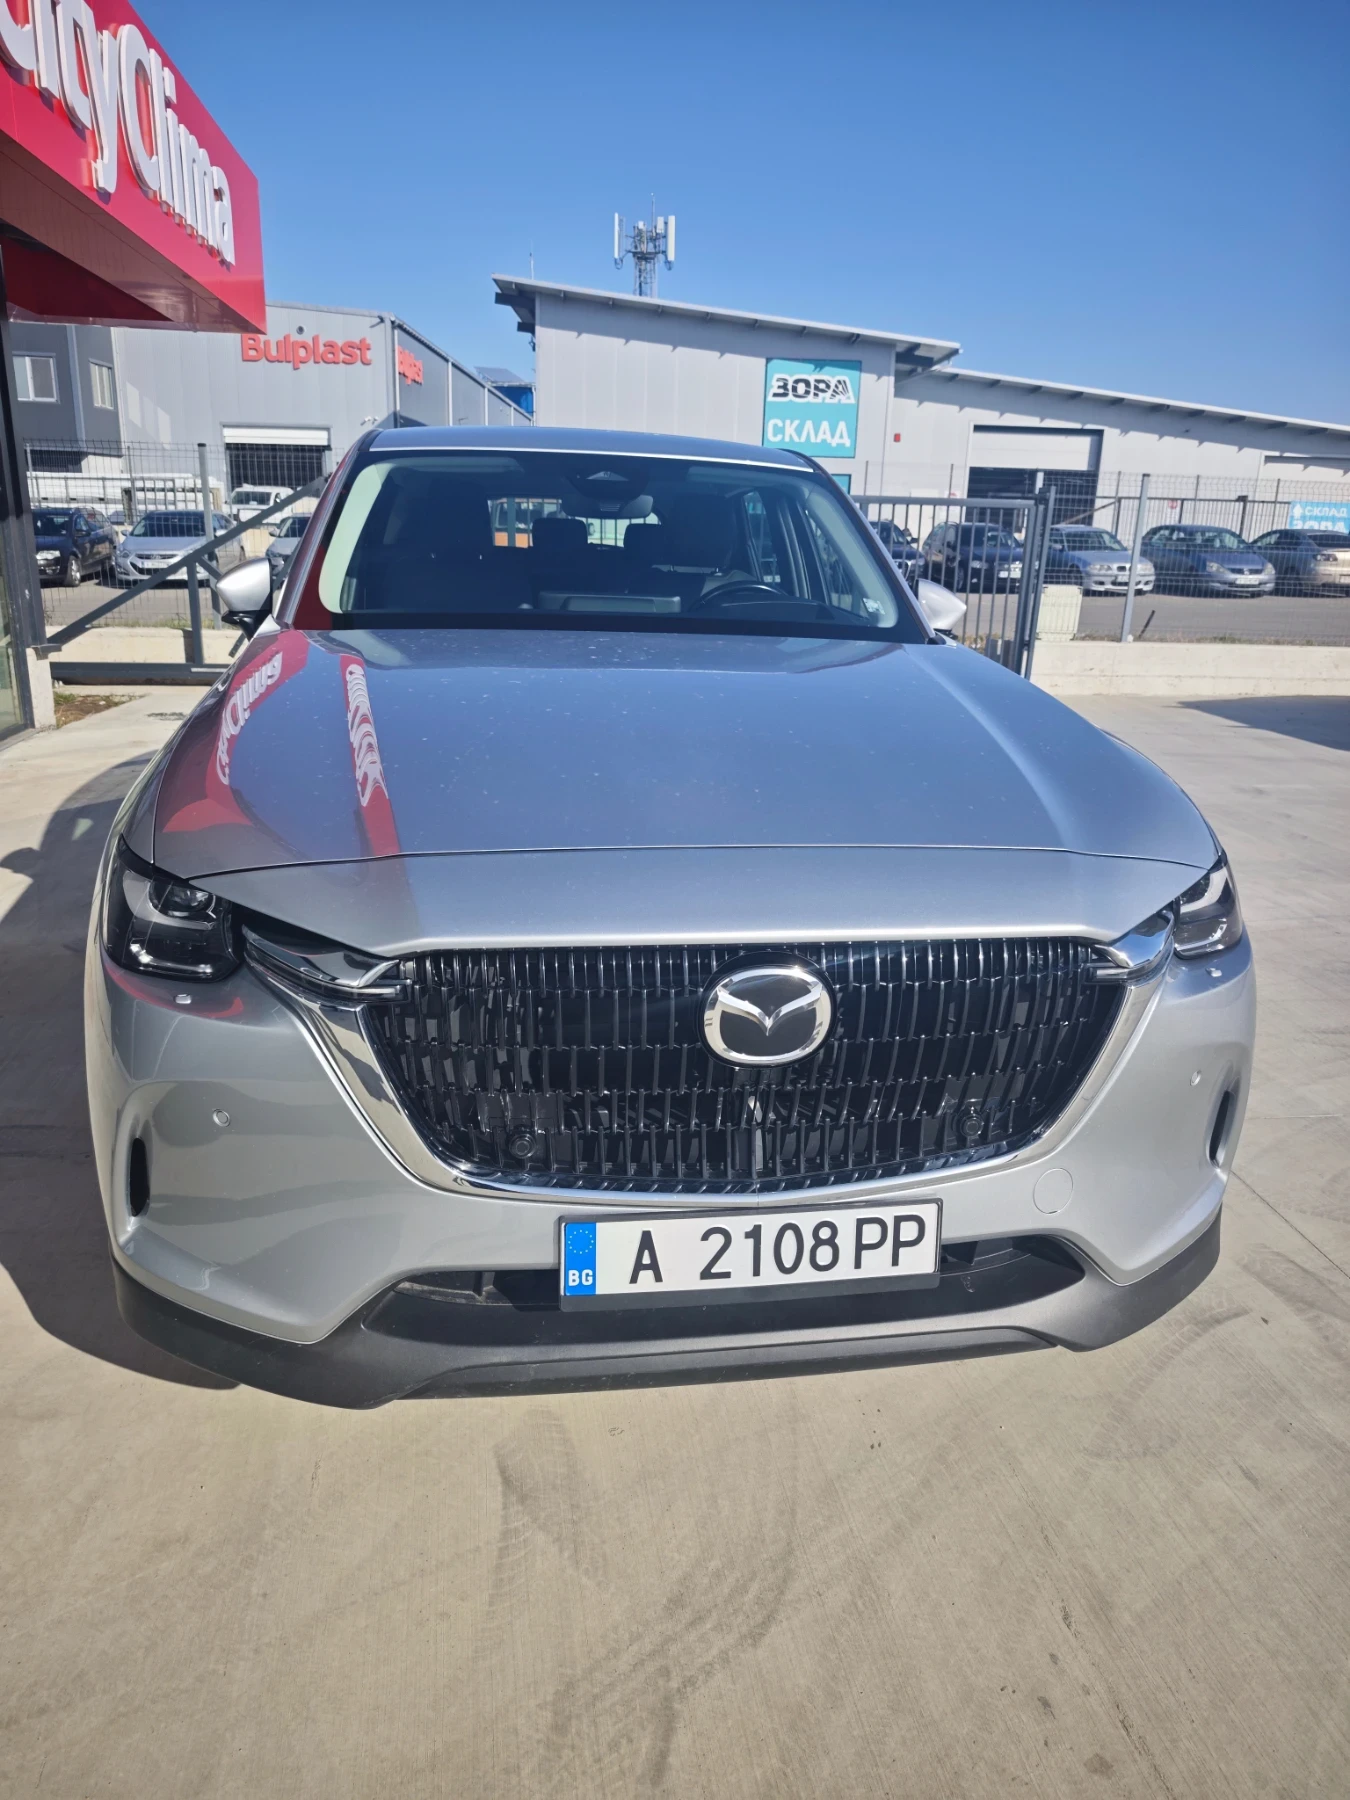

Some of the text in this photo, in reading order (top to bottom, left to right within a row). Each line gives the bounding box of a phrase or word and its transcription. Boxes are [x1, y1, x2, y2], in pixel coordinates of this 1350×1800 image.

[241, 333, 372, 369] Bulplast
[769, 375, 854, 402] ЗОРА
[767, 418, 851, 447] СКЛАД
[1304, 506, 1348, 518] СКЛАД
[629, 1229, 664, 1285] A
[568, 1269, 594, 1287] BG
